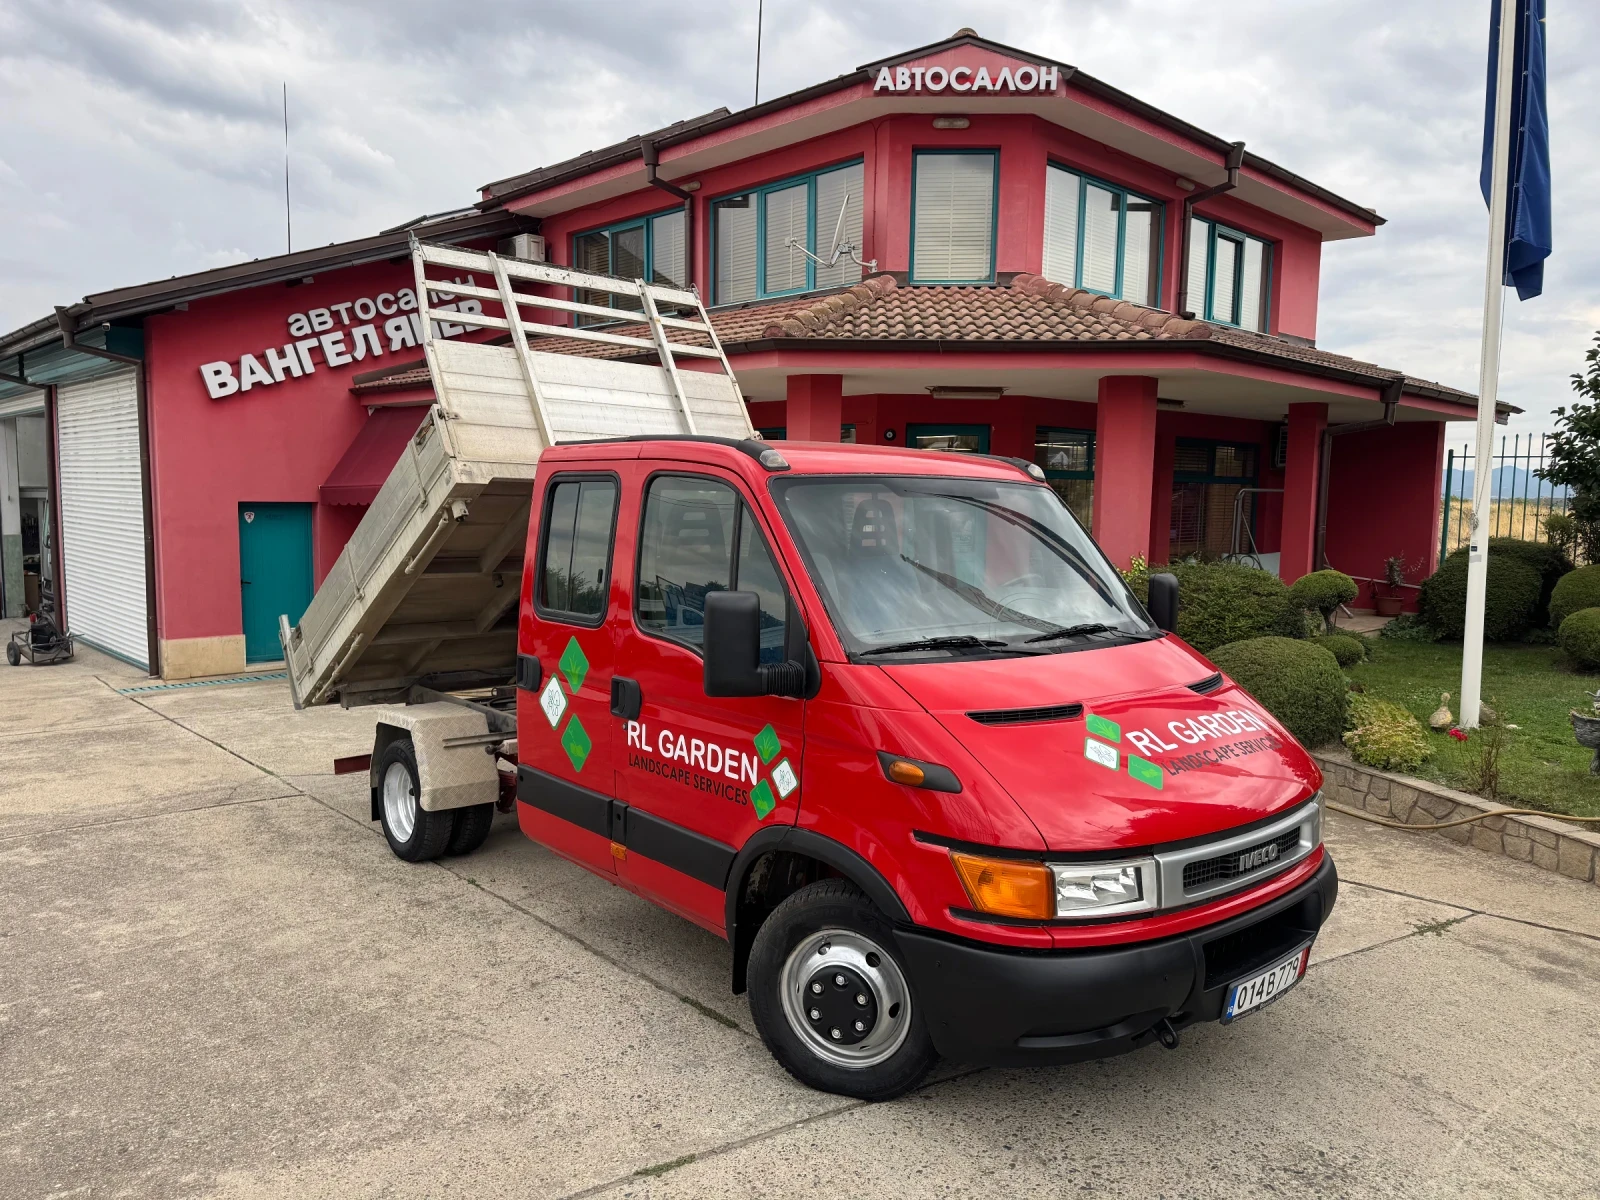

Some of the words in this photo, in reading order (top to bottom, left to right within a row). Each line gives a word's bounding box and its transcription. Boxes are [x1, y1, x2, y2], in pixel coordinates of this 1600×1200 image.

[873, 66, 1058, 92] АВТОСАЛОН
[199, 323, 384, 400] ВАНГЕЛ
[627, 720, 652, 752] RL
[658, 729, 758, 786] GARDEN
[1125, 728, 1178, 756] RL
[1167, 709, 1269, 744] GARDEN
[628, 752, 690, 786] LANDSCAPE
[693, 774, 748, 806] SERVICES
[1161, 743, 1240, 776] LANDSCAPE
[1238, 843, 1278, 872] IVECO
